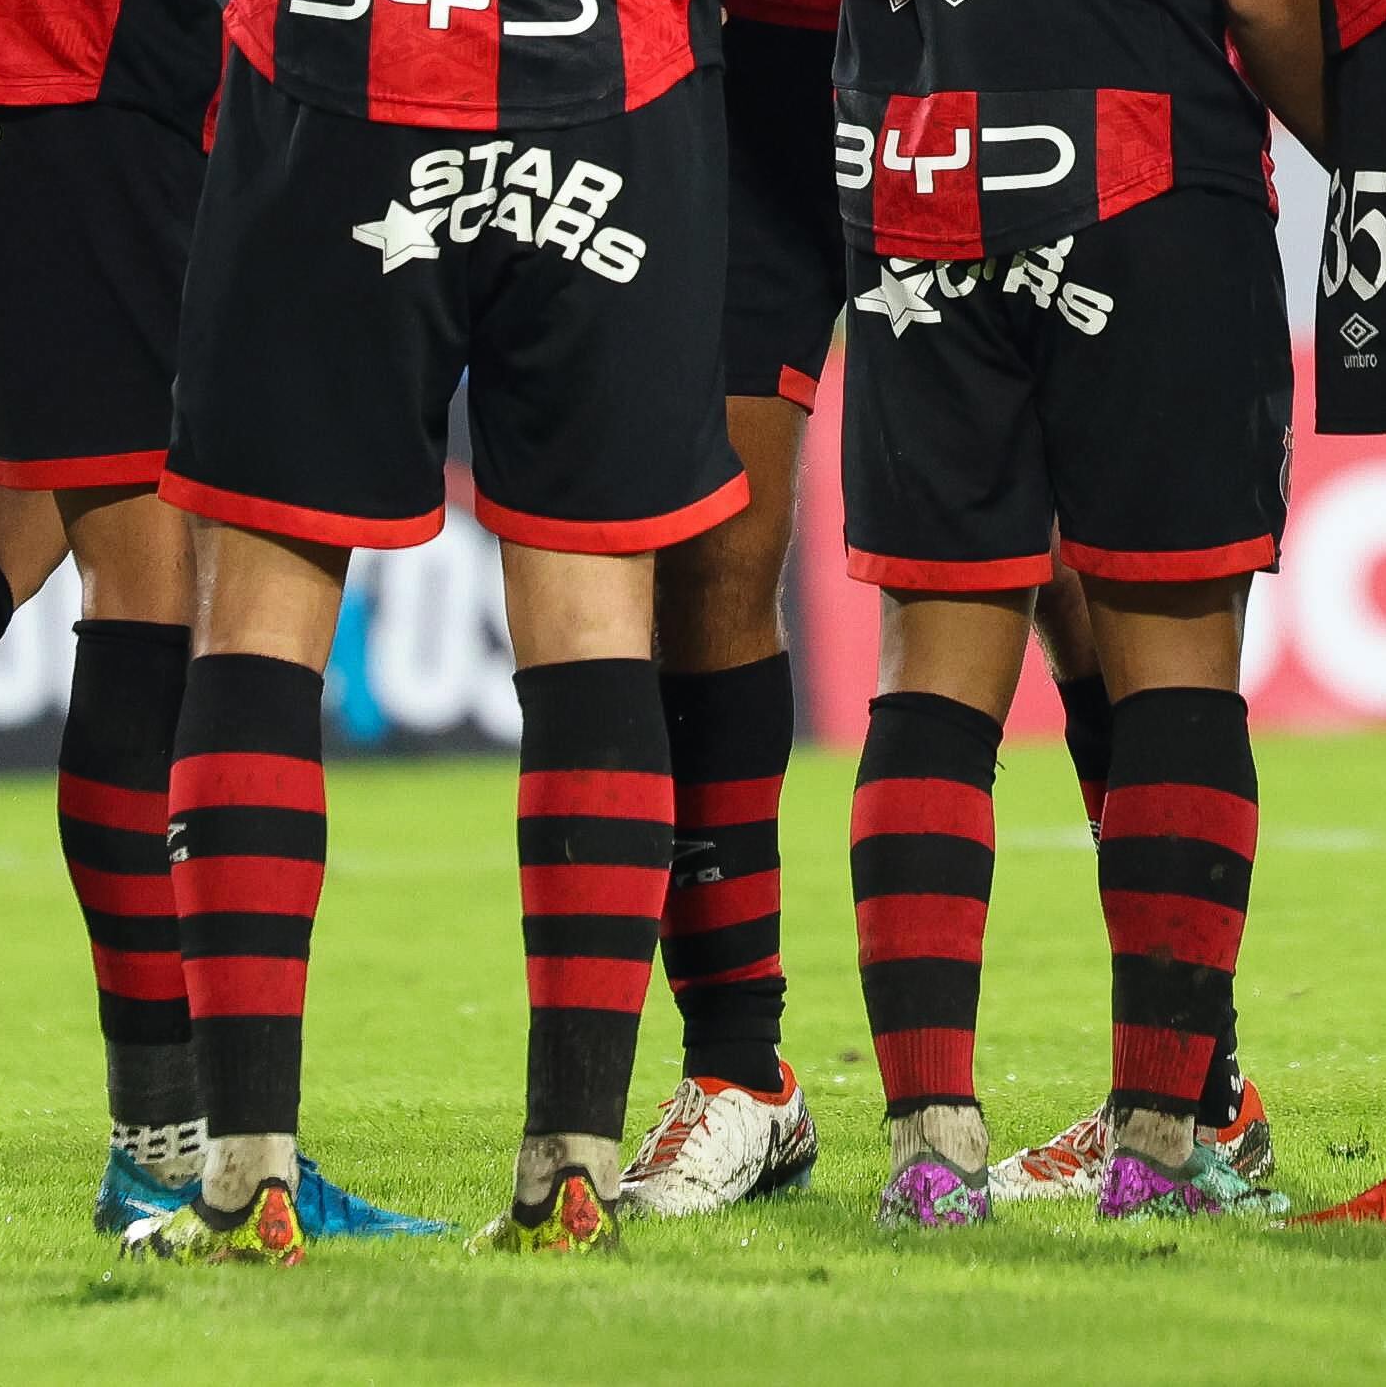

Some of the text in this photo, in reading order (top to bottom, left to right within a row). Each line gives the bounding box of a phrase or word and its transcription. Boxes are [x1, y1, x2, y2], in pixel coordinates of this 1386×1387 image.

[410, 141, 623, 219] STAR
[835, 122, 1076, 194] BYD
[449, 188, 647, 284] CARS
[1344, 353, 1378, 369] umbro
